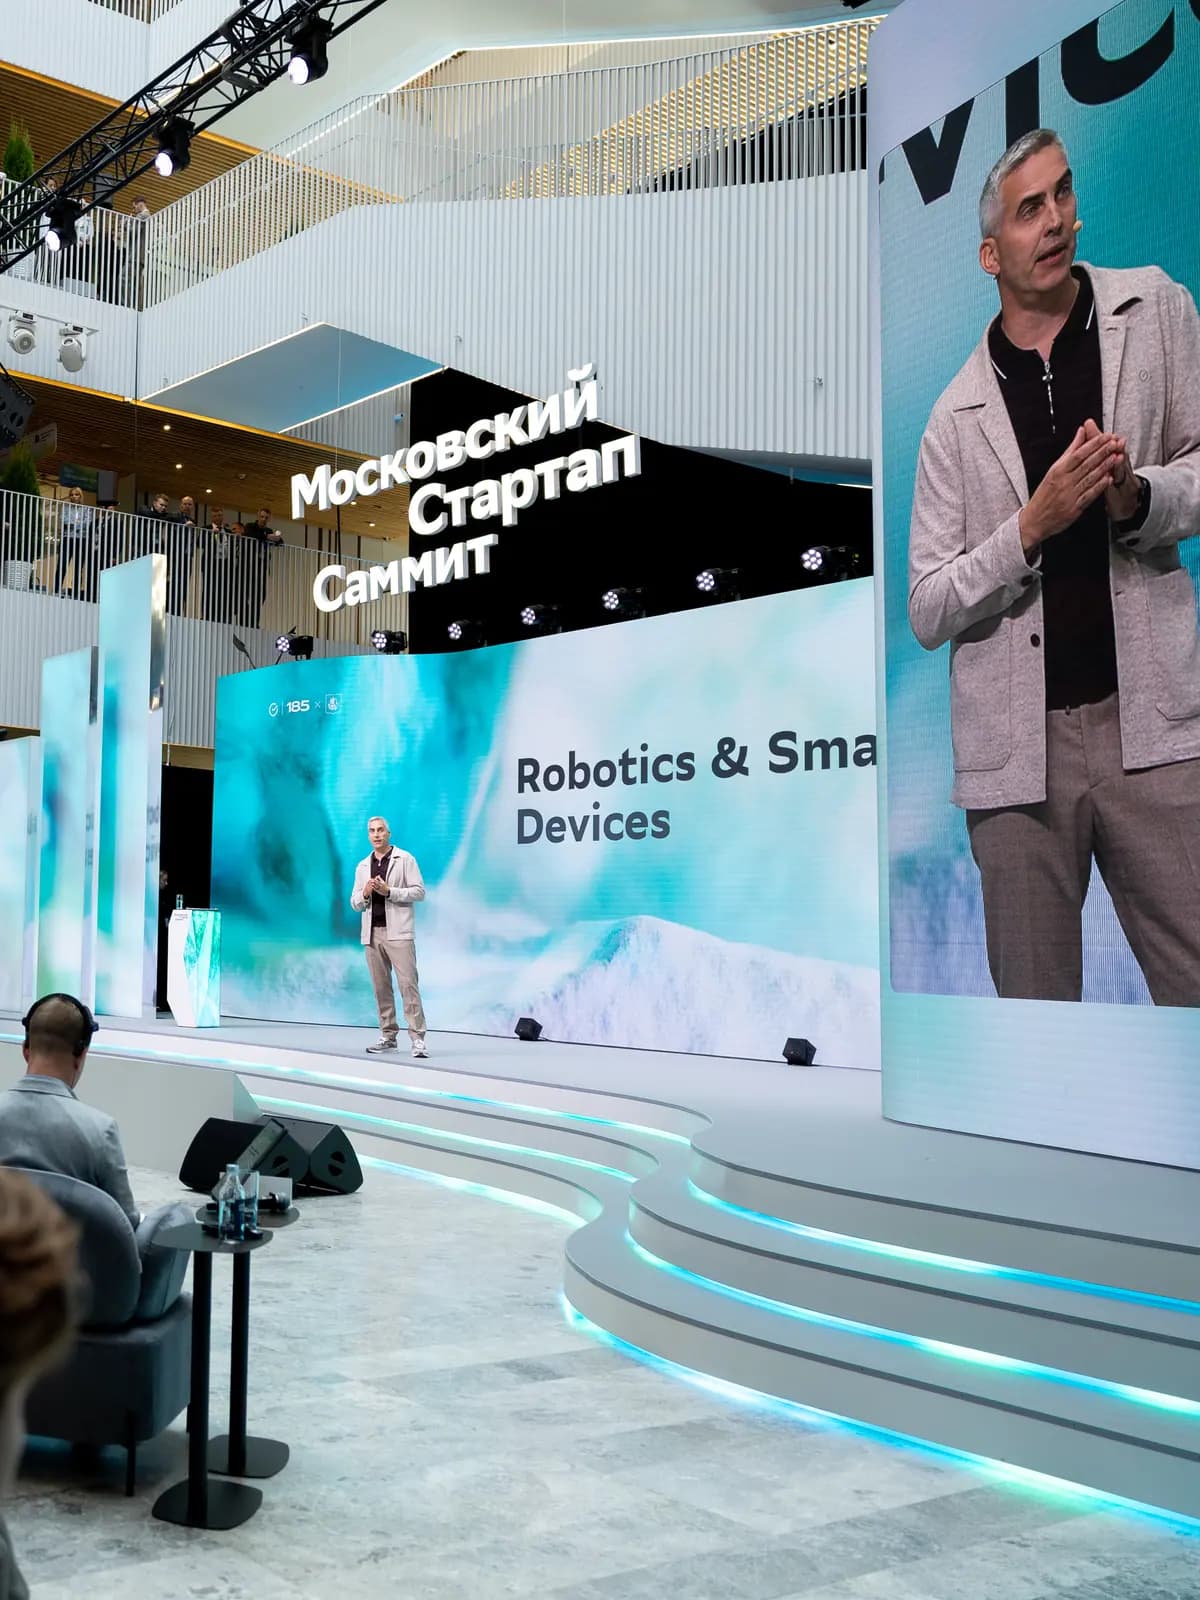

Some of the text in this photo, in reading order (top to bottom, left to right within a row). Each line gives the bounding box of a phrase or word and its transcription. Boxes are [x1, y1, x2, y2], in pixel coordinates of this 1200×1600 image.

[291, 362, 600, 521] Московский
[408, 434, 642, 536] Стартап
[313, 533, 499, 613] Саммит
[286, 699, 310, 713] 185
[517, 743, 695, 794] Robotics
[711, 736, 749, 779] &
[517, 801, 671, 845] Devices
